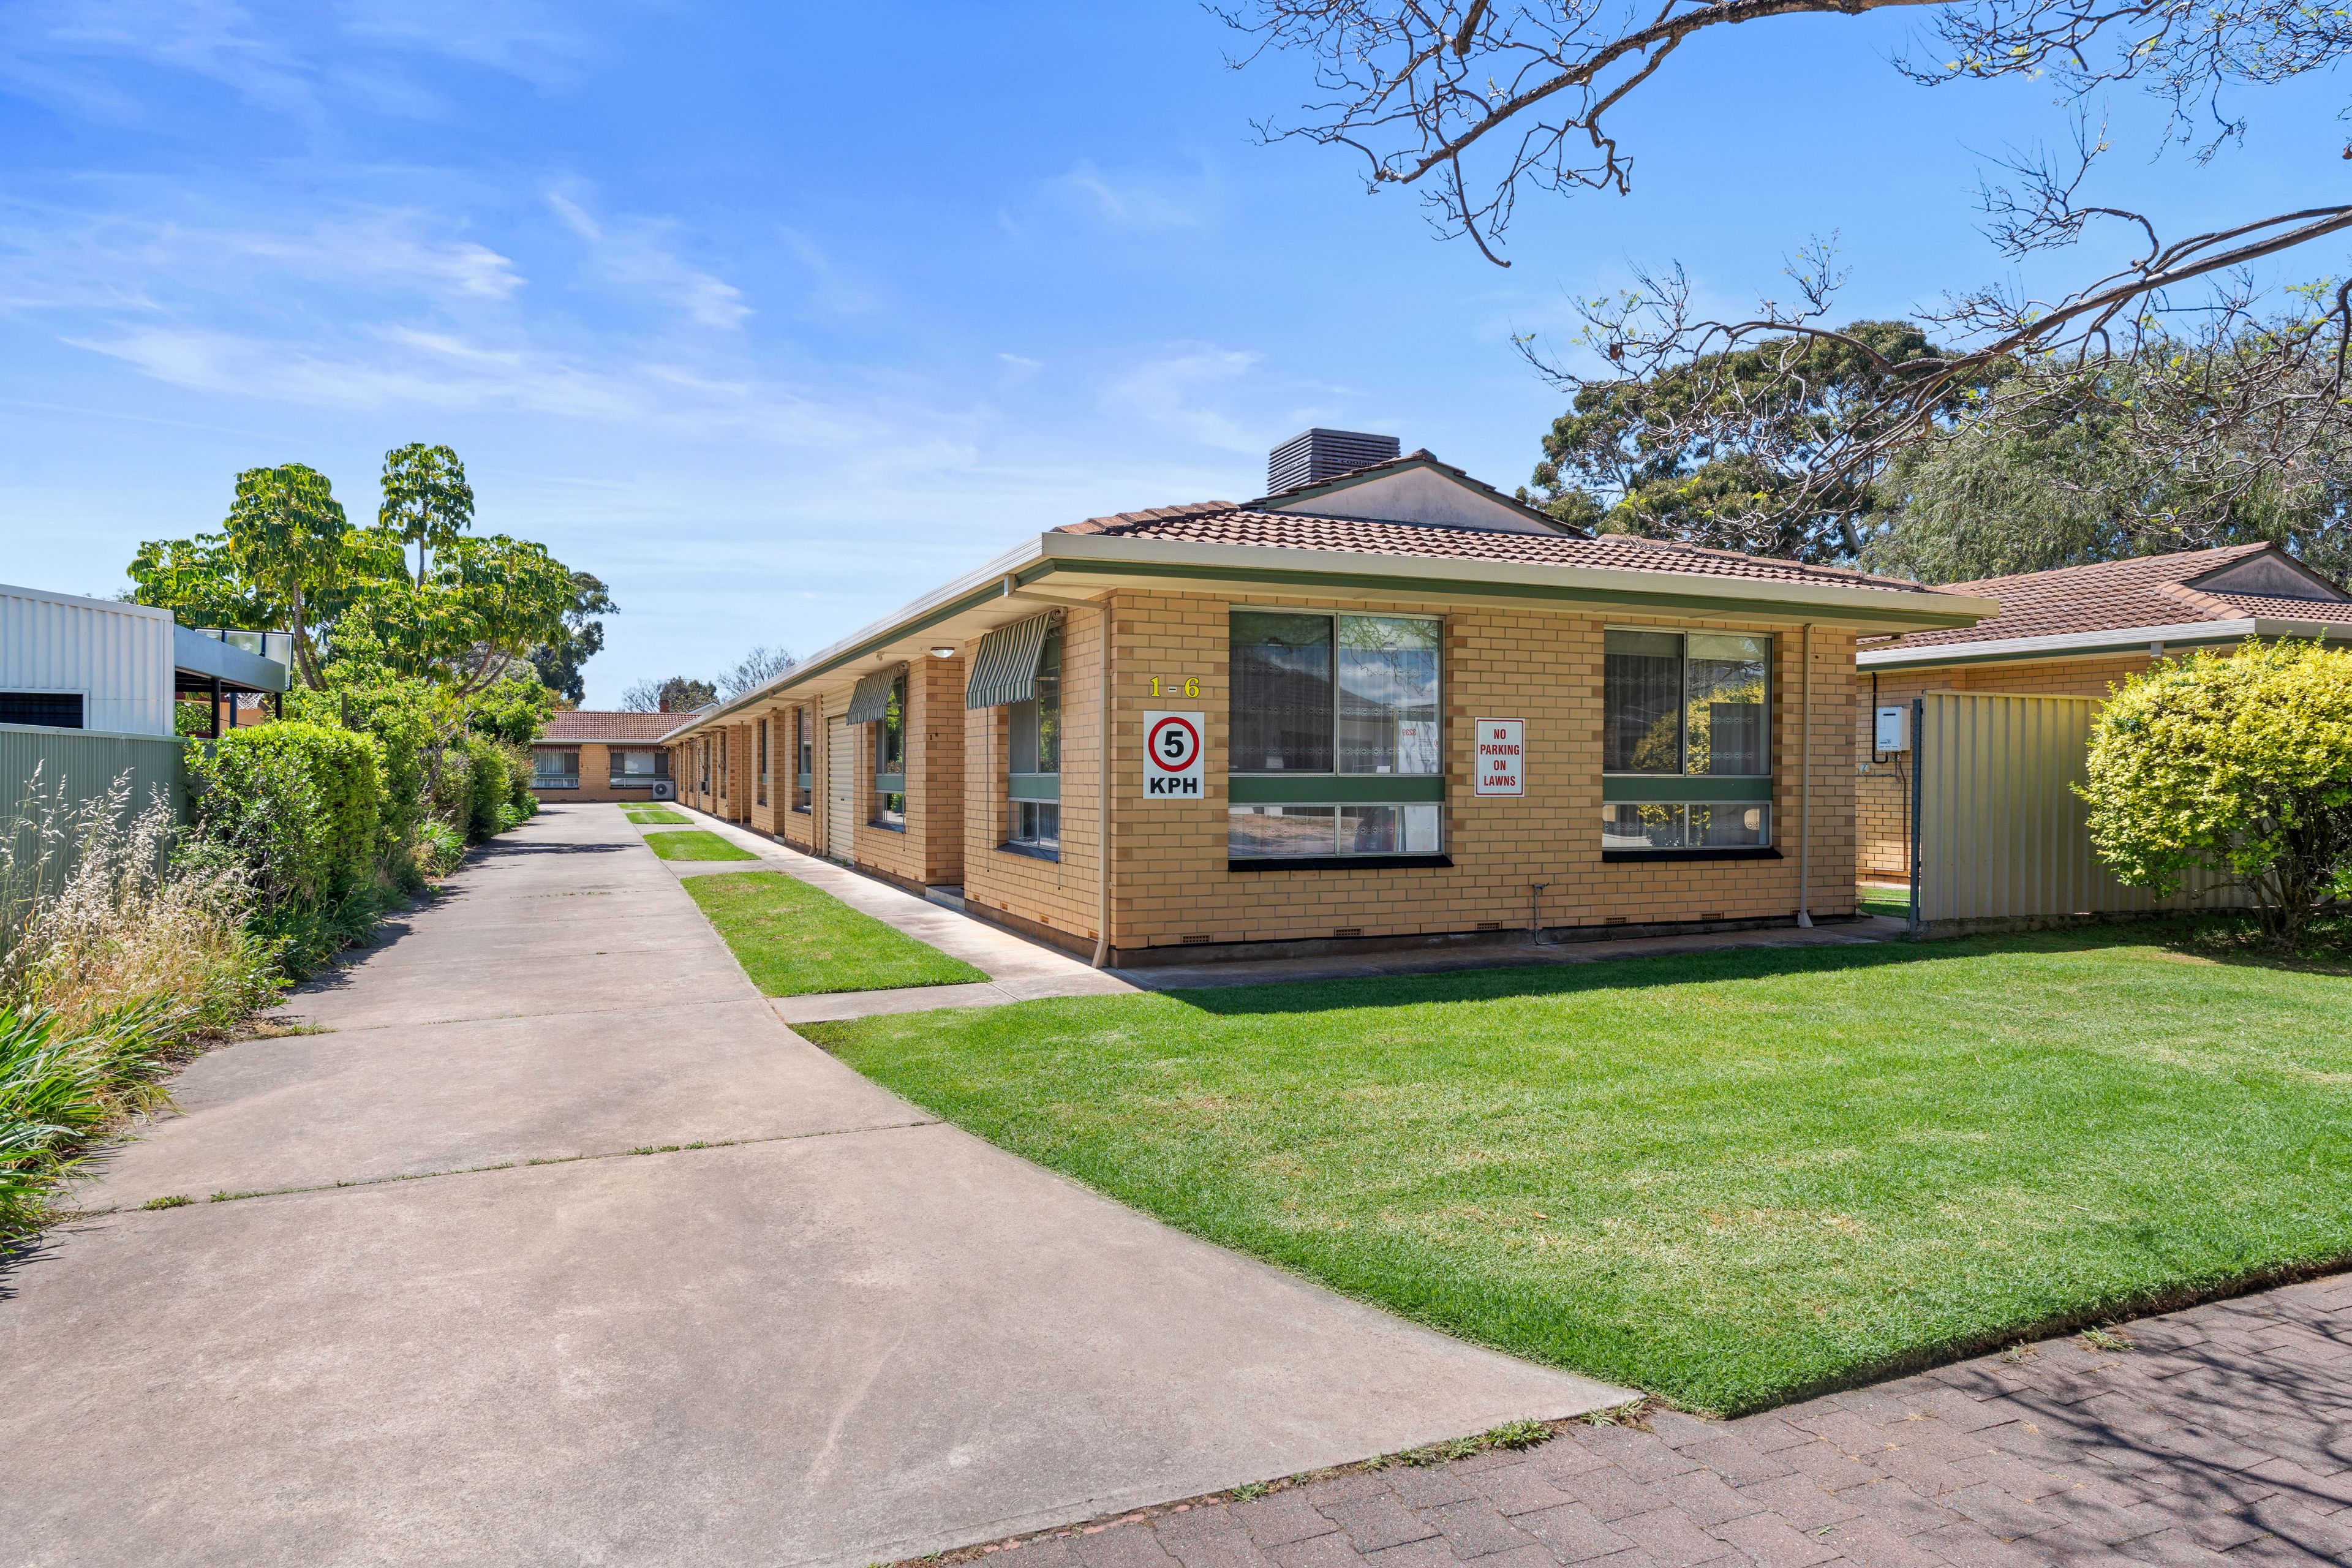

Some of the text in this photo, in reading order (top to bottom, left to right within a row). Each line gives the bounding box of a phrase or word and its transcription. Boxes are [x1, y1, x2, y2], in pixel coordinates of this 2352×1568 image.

[1278, 462, 1296, 475] coolair
[1493, 729, 1506, 739] NO
[1164, 731, 1185, 758] 5
[1480, 744, 1520, 755] PARKING
[1493, 760, 1506, 771] ON
[1150, 777, 1197, 794] KPH
[1483, 775, 1516, 786] LAWNS
